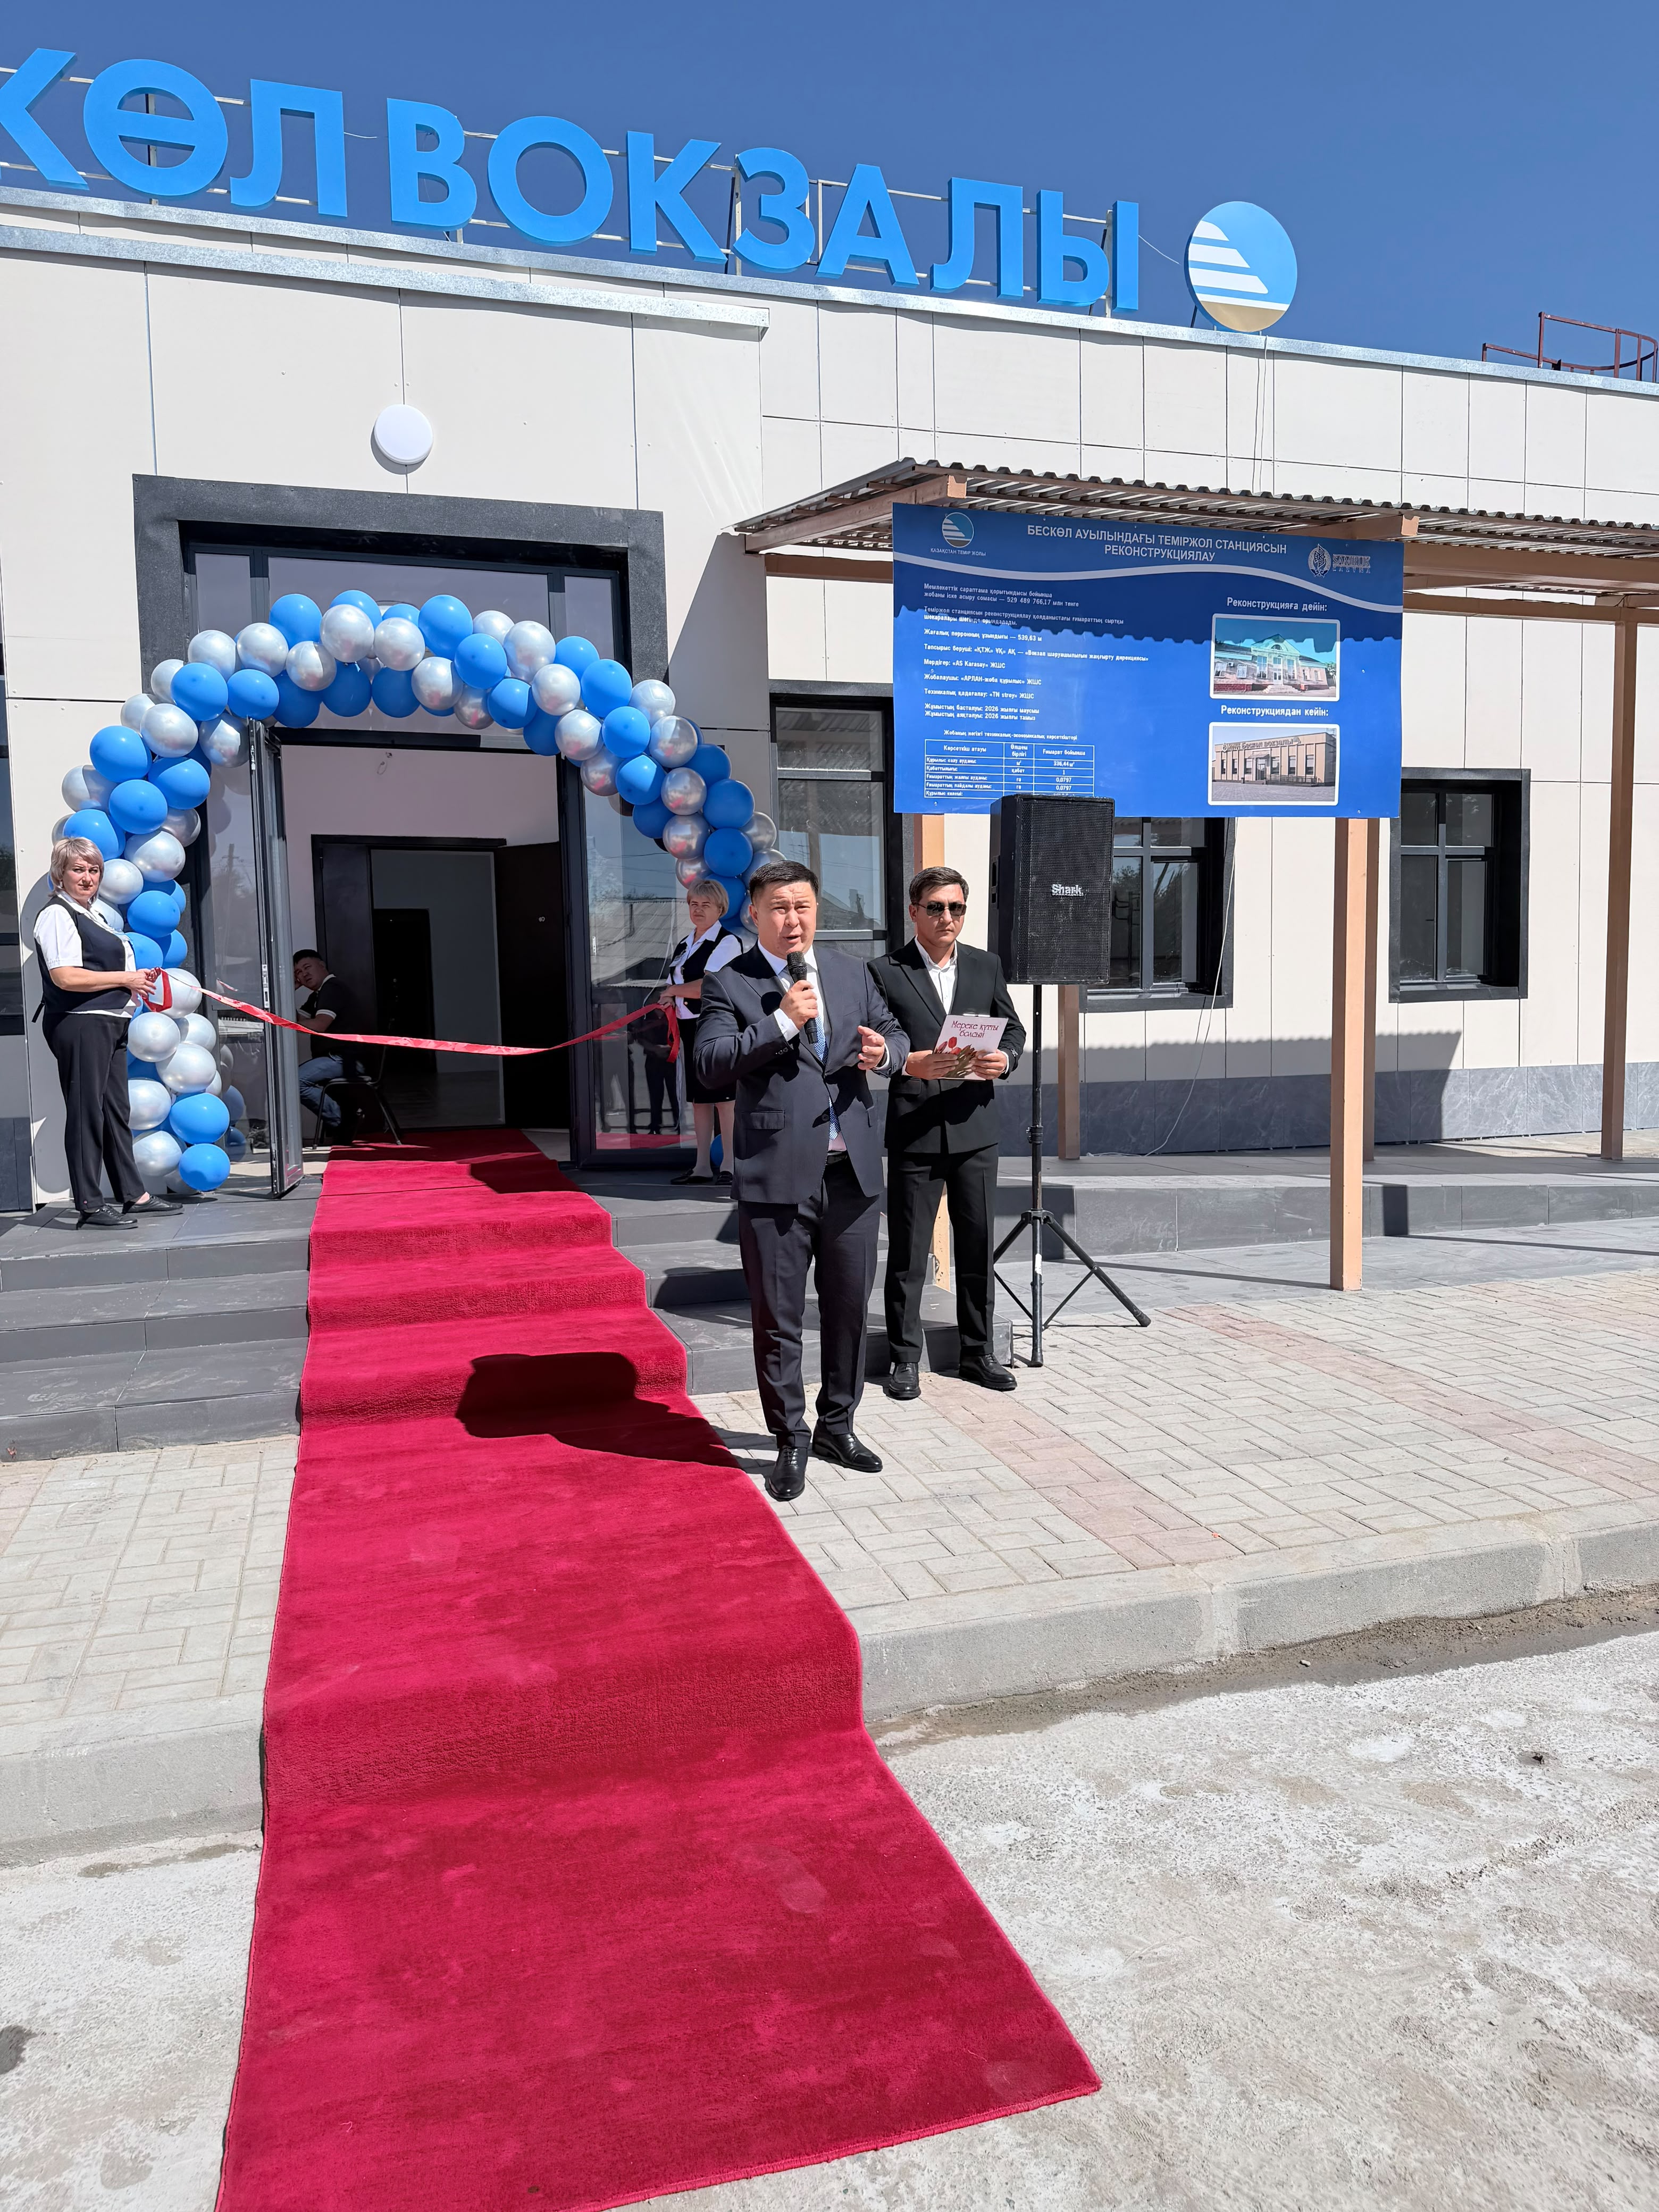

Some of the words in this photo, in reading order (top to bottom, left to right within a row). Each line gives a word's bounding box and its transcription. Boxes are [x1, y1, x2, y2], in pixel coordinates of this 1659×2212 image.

[387, 98, 1138, 312] ВОКЗАЛЫ
[1028, 525, 1072, 538] БЕСКӨЛ
[1075, 529, 1155, 544] АУЫЛЫНДАҒЫ
[1158, 535, 1212, 548] ТЕМІРЖОЛ
[1216, 539, 1287, 554] СТАНЦИЯСЫН
[1104, 545, 1216, 562] РЕКОНСТРУКЦИЯЛАУ
[1333, 554, 1370, 568] SAMRUK
[1227, 597, 1298, 610] Реконструкцияға
[1302, 602, 1327, 612] дейін:
[985, 611, 1031, 620] реконструкциялау
[924, 643, 951, 652] Тапсырыс
[1221, 705, 1301, 716] Реконструкциядан
[1304, 707, 1329, 716] кейін:
[1052, 884, 1083, 894] Shark
[951, 1020, 978, 1030] Мереке
